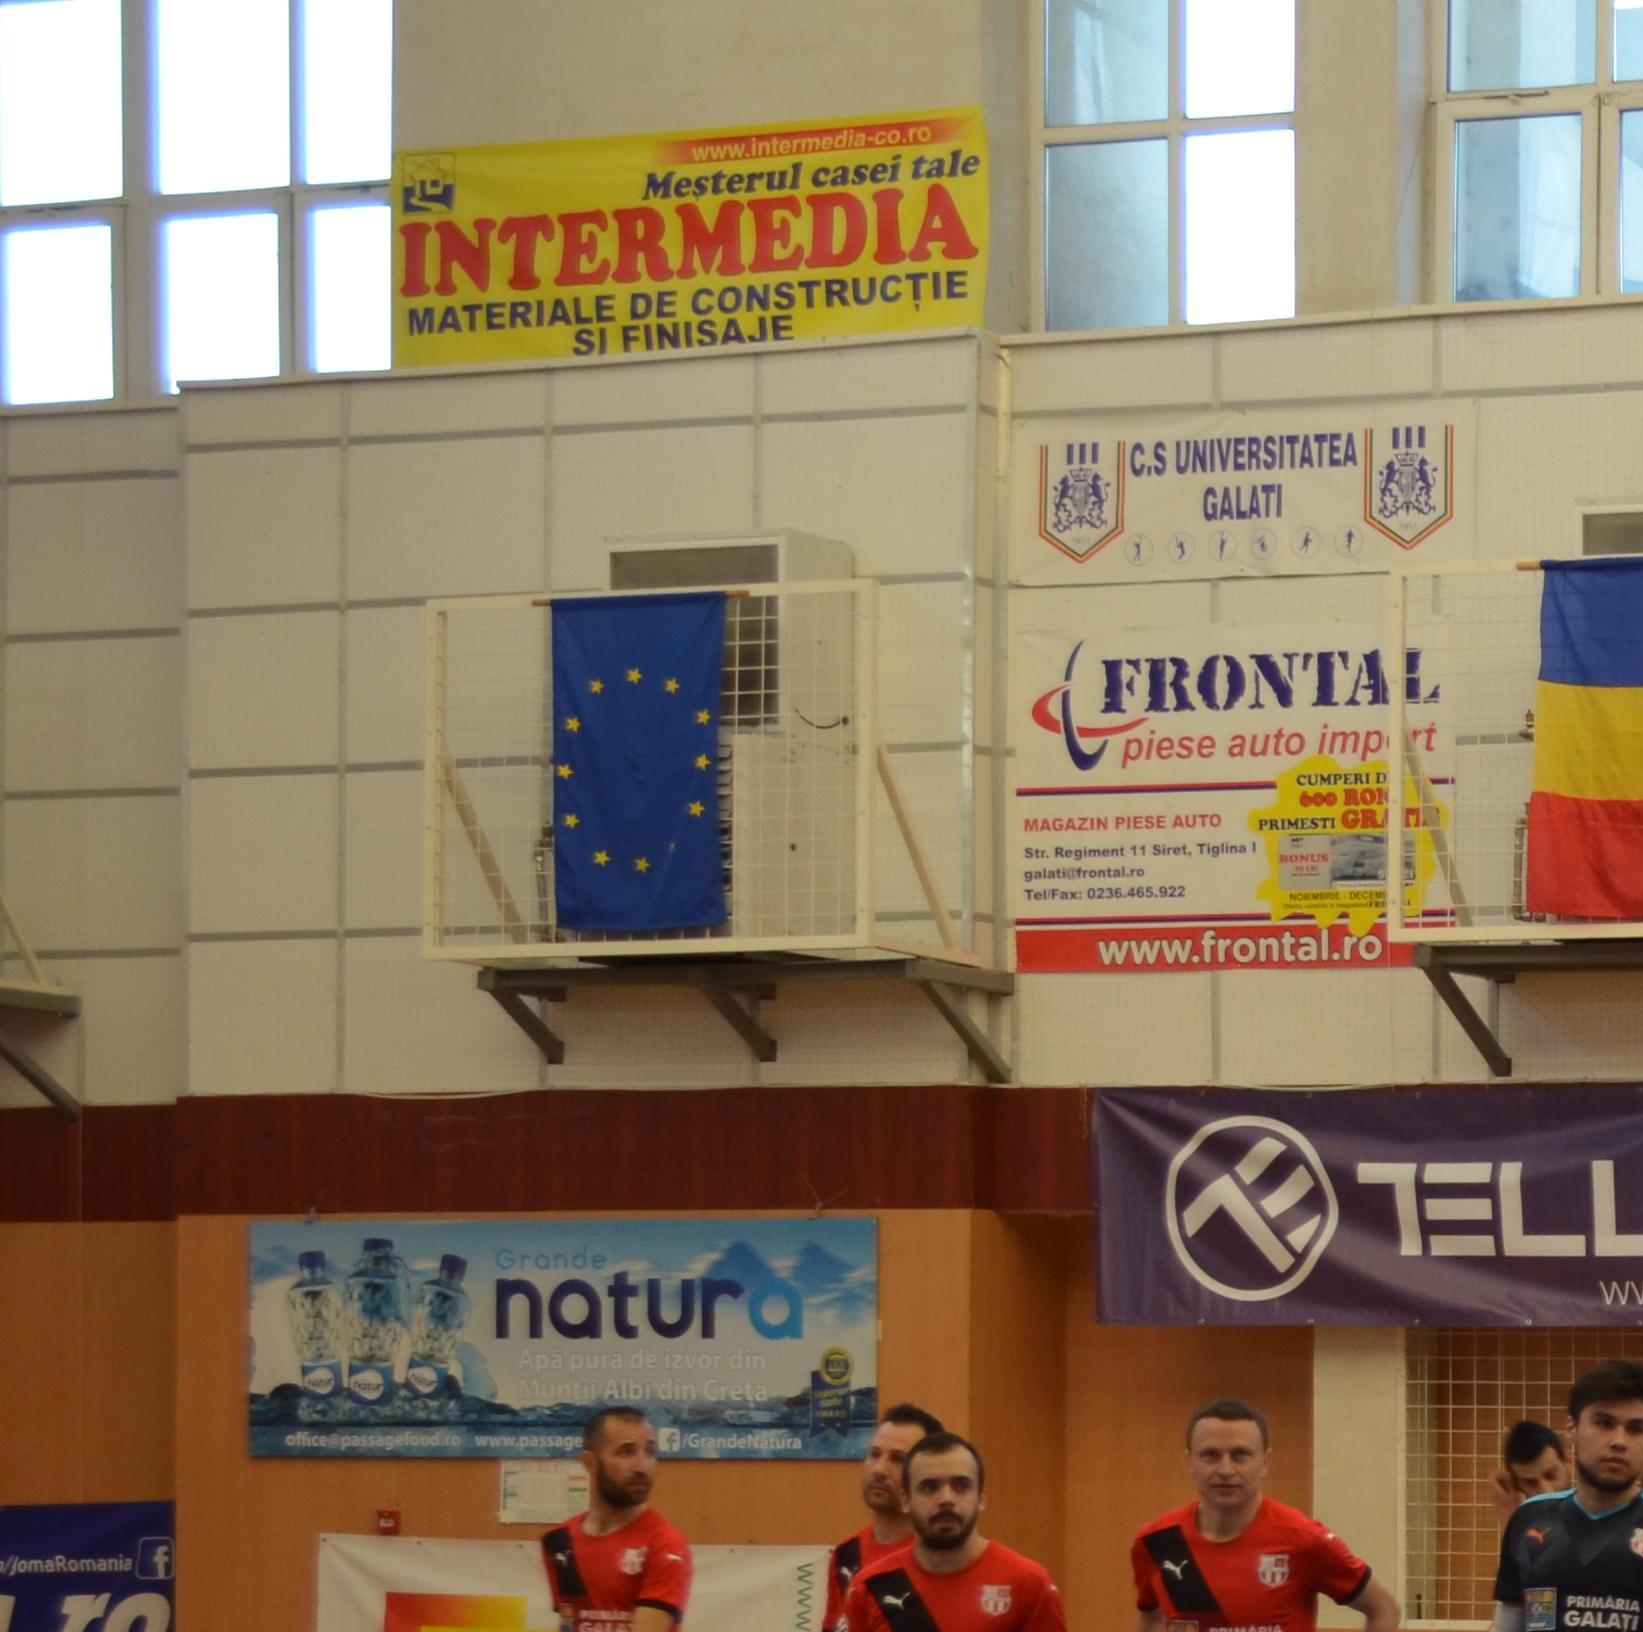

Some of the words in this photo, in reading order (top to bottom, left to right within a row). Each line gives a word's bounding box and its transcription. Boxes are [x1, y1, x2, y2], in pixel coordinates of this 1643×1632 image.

[692, 126, 931, 161] www.intermedia-co.ro
[812, 155, 902, 187] casei
[912, 150, 981, 178] tale
[399, 183, 979, 298] INTERMEDIA
[408, 295, 616, 336] MATERIALE
[629, 290, 678, 319] DE
[691, 270, 969, 314] CONSTRUCȚIE
[572, 328, 608, 357] SI
[622, 315, 795, 353] FINISAJE
[1130, 441, 1168, 477] C.S
[1175, 432, 1358, 475] UNIVERSITATEA
[1202, 484, 1283, 522] GALATI
[1100, 648, 1441, 714] FRONTAL
[1121, 729, 1216, 769] piese
[1227, 726, 1307, 759] auto
[1317, 722, 1438, 762] imprt
[1296, 772, 1371, 786] CUMPERI
[1023, 816, 1109, 833] MAGAZIN
[1115, 814, 1167, 830] PIESE
[1172, 813, 1222, 829] AUTO
[1259, 816, 1336, 832] PRIMESTI
[1024, 847, 1050, 860] Str.
[1054, 845, 1125, 862] Regiment
[1131, 844, 1147, 857] 11
[1152, 843, 1191, 858] Siret,
[1196, 842, 1247, 858] Tiglina
[1279, 853, 1330, 864] BONUS
[1024, 866, 1145, 883] galati@frontal.ro
[1024, 888, 1083, 901] Tel/Fax:
[1086, 885, 1186, 901] 0236.465.922
[1097, 928, 1384, 967] www.frontal.ro
[495, 1246, 607, 1271] Grande
[495, 1270, 805, 1340] natura
[629, 1347, 659, 1370] de
[664, 1347, 722, 1370] izvor
[729, 1347, 767, 1370] din
[602, 1376, 651, 1400] Albi
[658, 1376, 698, 1400] din
[284, 1431, 462, 1450] office@passagefood.ro
[475, 1434, 583, 1451] www.passage
[0, 1554, 133, 1576] /JomaRomania
